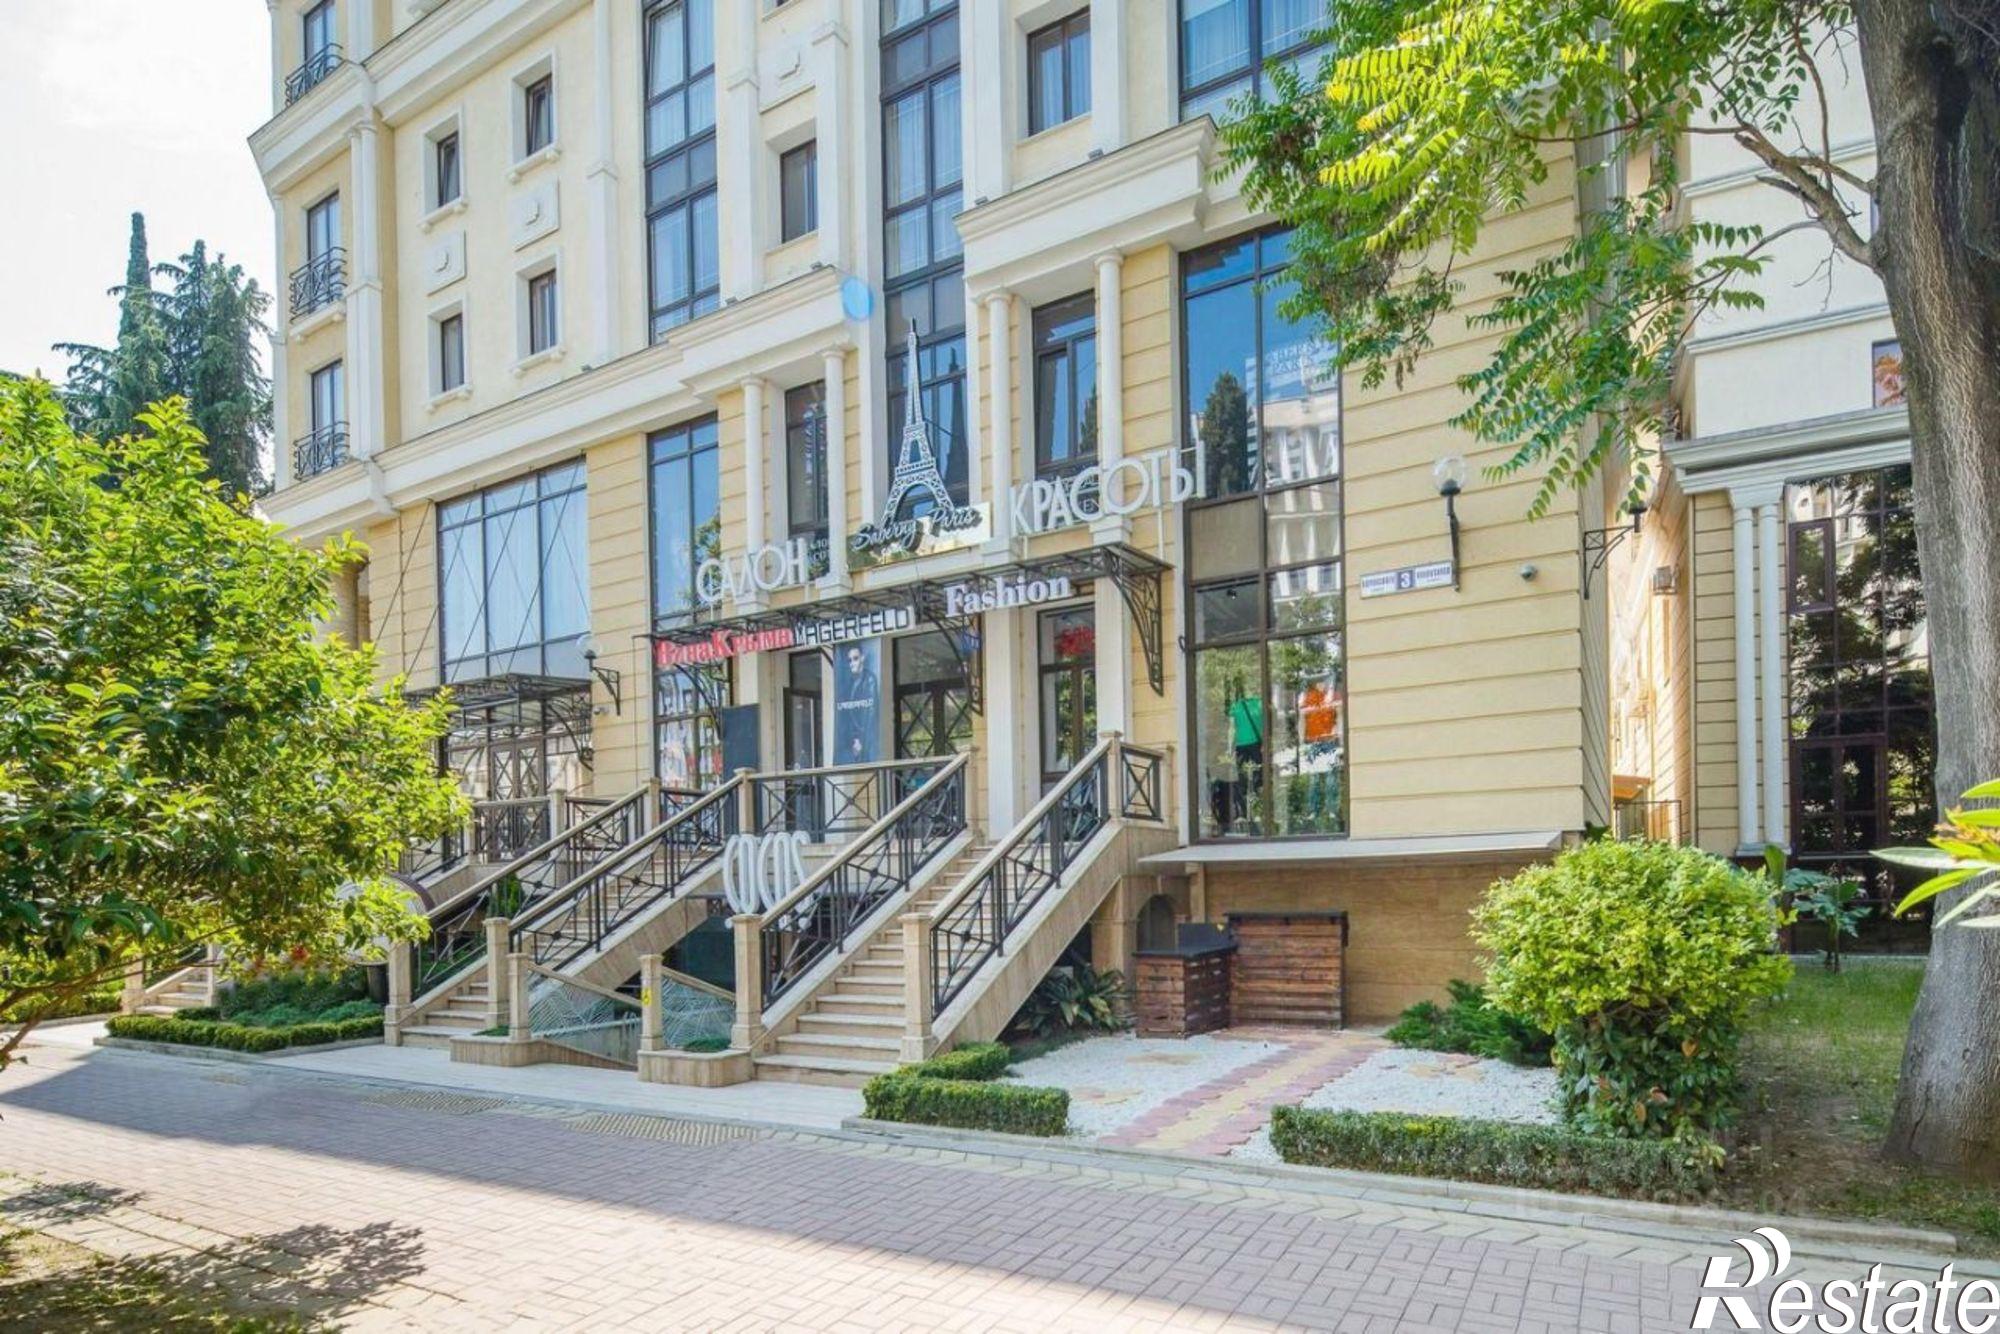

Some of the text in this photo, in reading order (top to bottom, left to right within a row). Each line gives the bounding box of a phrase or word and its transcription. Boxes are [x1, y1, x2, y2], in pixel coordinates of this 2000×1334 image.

[1009, 440, 1207, 537] КРАСОТЫ
[927, 506, 981, 531] Paris
[696, 537, 806, 605] САЛОН
[1400, 572, 1411, 589] 3
[943, 575, 1074, 618] Fashion
